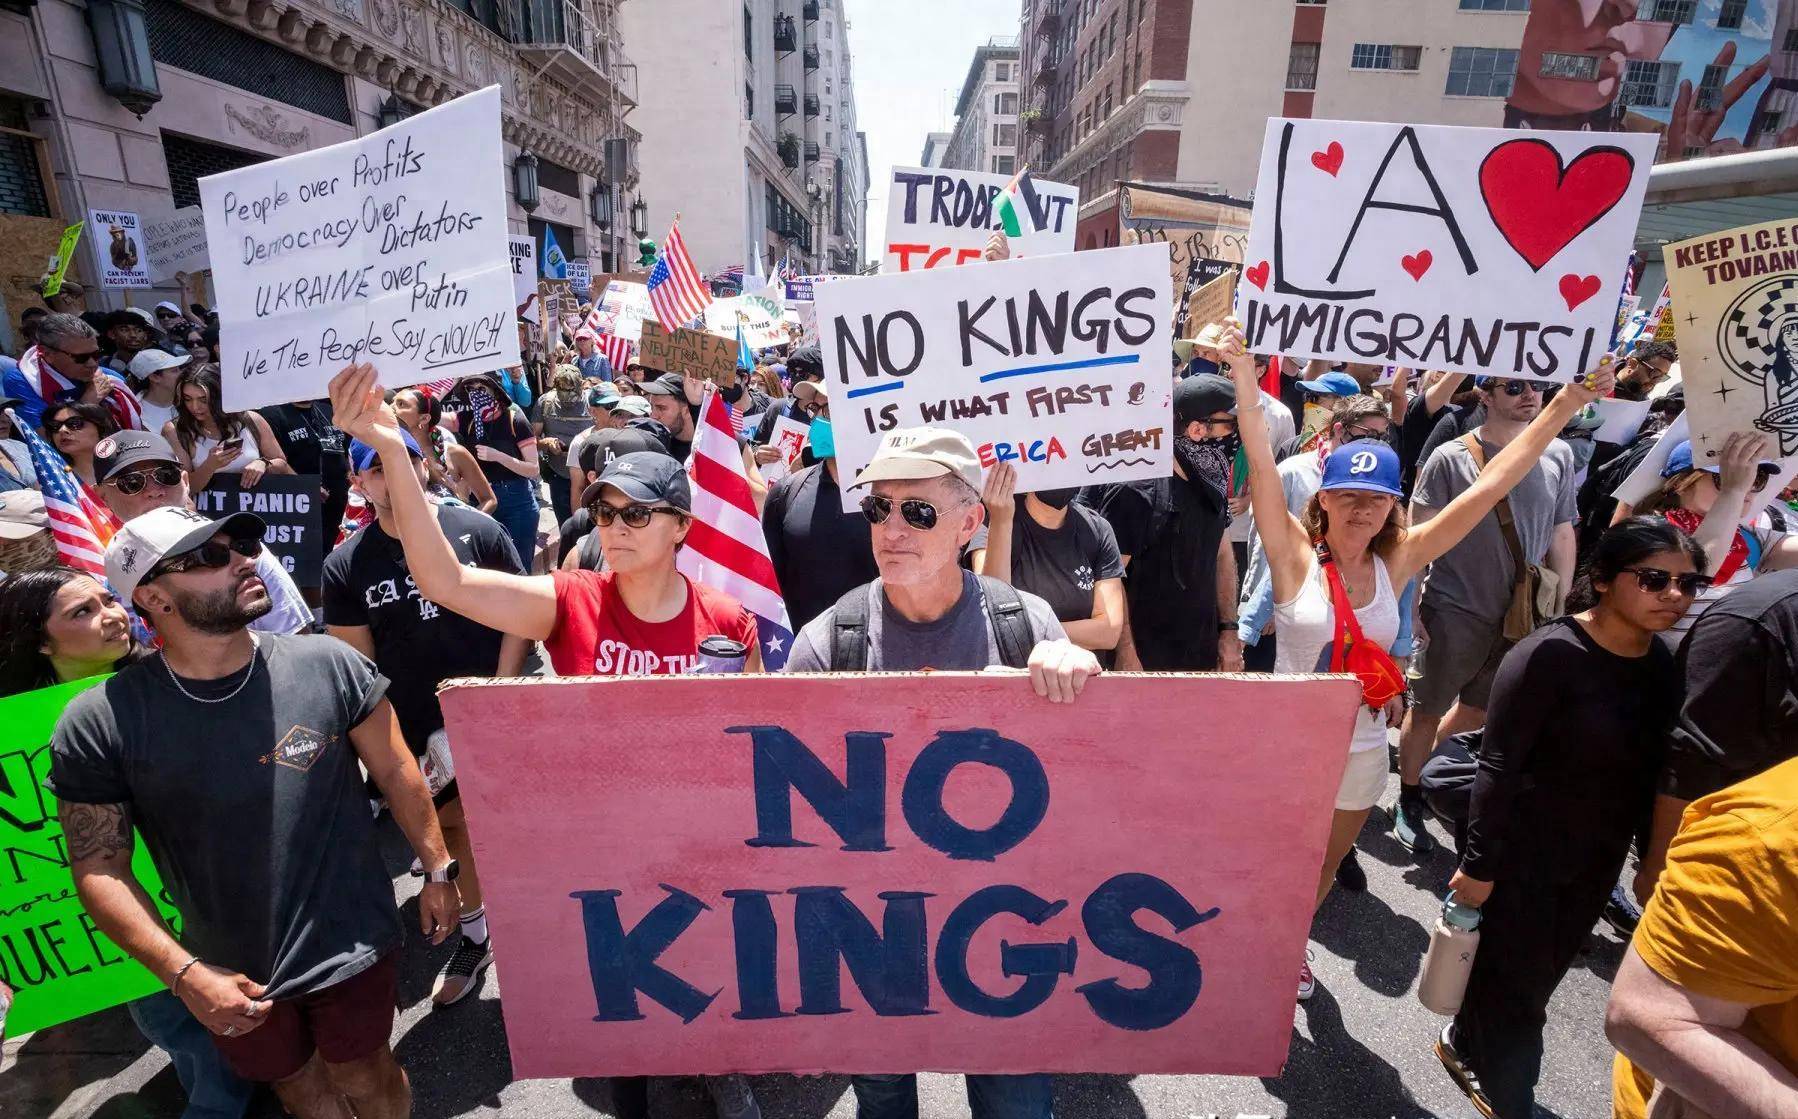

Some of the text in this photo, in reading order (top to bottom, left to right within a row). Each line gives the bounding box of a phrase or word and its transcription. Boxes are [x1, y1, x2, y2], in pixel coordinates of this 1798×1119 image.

[224, 136, 425, 226] People over Profits
[96, 213, 136, 226] ONLY YOU
[895, 172, 1004, 231] TROOP
[1274, 122, 1479, 299] LA
[243, 195, 407, 266] Democracy Over
[380, 200, 482, 254] Dictators
[1675, 237, 1735, 268] KEEP
[1740, 227, 1788, 254] I.C.E
[1702, 249, 1798, 285] TOVAAN
[255, 260, 427, 317] UKRAINE over
[1205, 265, 1222, 274] was
[412, 272, 468, 312] Putin
[643, 322, 661, 338] I
[714, 340, 728, 355] A
[749, 321, 770, 330] THIS
[834, 310, 925, 384] NO
[957, 287, 1156, 367] KINGS
[1247, 300, 1596, 382] IMMIGRANTS!
[242, 349, 268, 380] We
[272, 335, 309, 370] The
[319, 321, 385, 365] People
[388, 319, 426, 361] Say
[425, 312, 505, 364] ENOUGH
[641, 339, 736, 371] NEUTRAL ASS
[864, 403, 899, 434] IS
[919, 391, 1010, 423] WHAT
[1026, 384, 1112, 418] FIRST
[604, 446, 616, 465] LA
[1081, 427, 1164, 457] GREAT
[1350, 452, 1378, 474] D
[193, 489, 310, 514] N'T PANIC
[417, 597, 441, 621] LA
[595, 639, 660, 674] STOP
[285, 740, 318, 757] Modelo
[724, 724, 1050, 862] NO
[569, 871, 1221, 1032] KINGS
